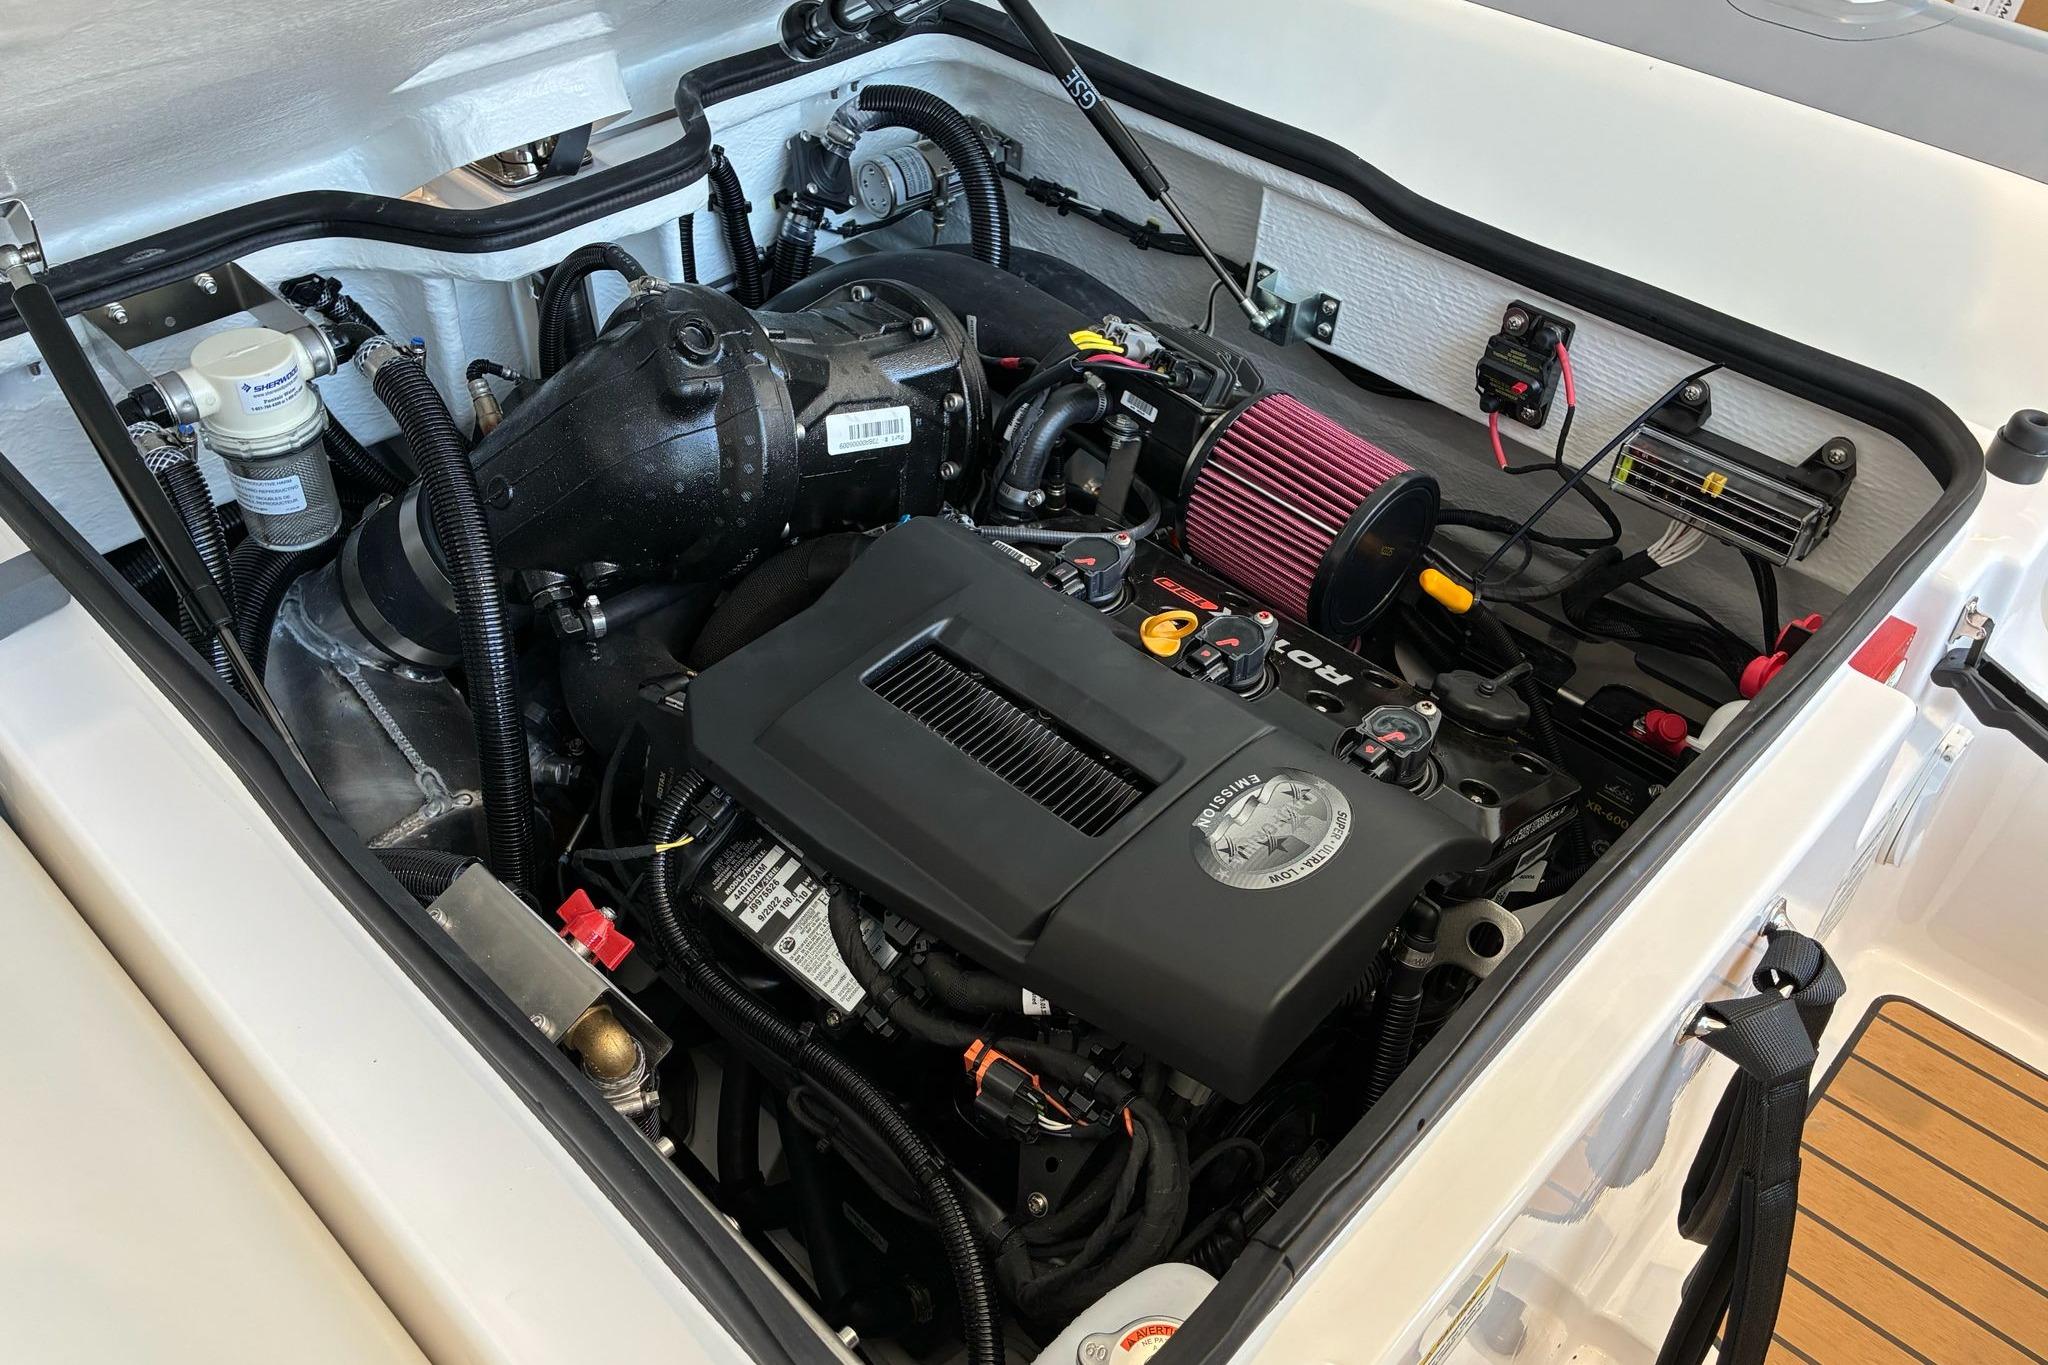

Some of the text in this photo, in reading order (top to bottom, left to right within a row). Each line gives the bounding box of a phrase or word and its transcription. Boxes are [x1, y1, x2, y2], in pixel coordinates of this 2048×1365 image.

[656, 771, 667, 800] ROTAX
[1197, 774, 1261, 828] EMISSION
[1586, 799, 1629, 830] XR-600
[1269, 810, 1348, 884] SUPER ULTRA LOW
[734, 863, 768, 900] 440103AM
[750, 879, 780, 913] J9975526
[757, 896, 781, 922] 9/2022
[780, 891, 798, 910] 100.0
[795, 890, 808, 904] 110
[1136, 1326, 1175, 1340] AVERTI
